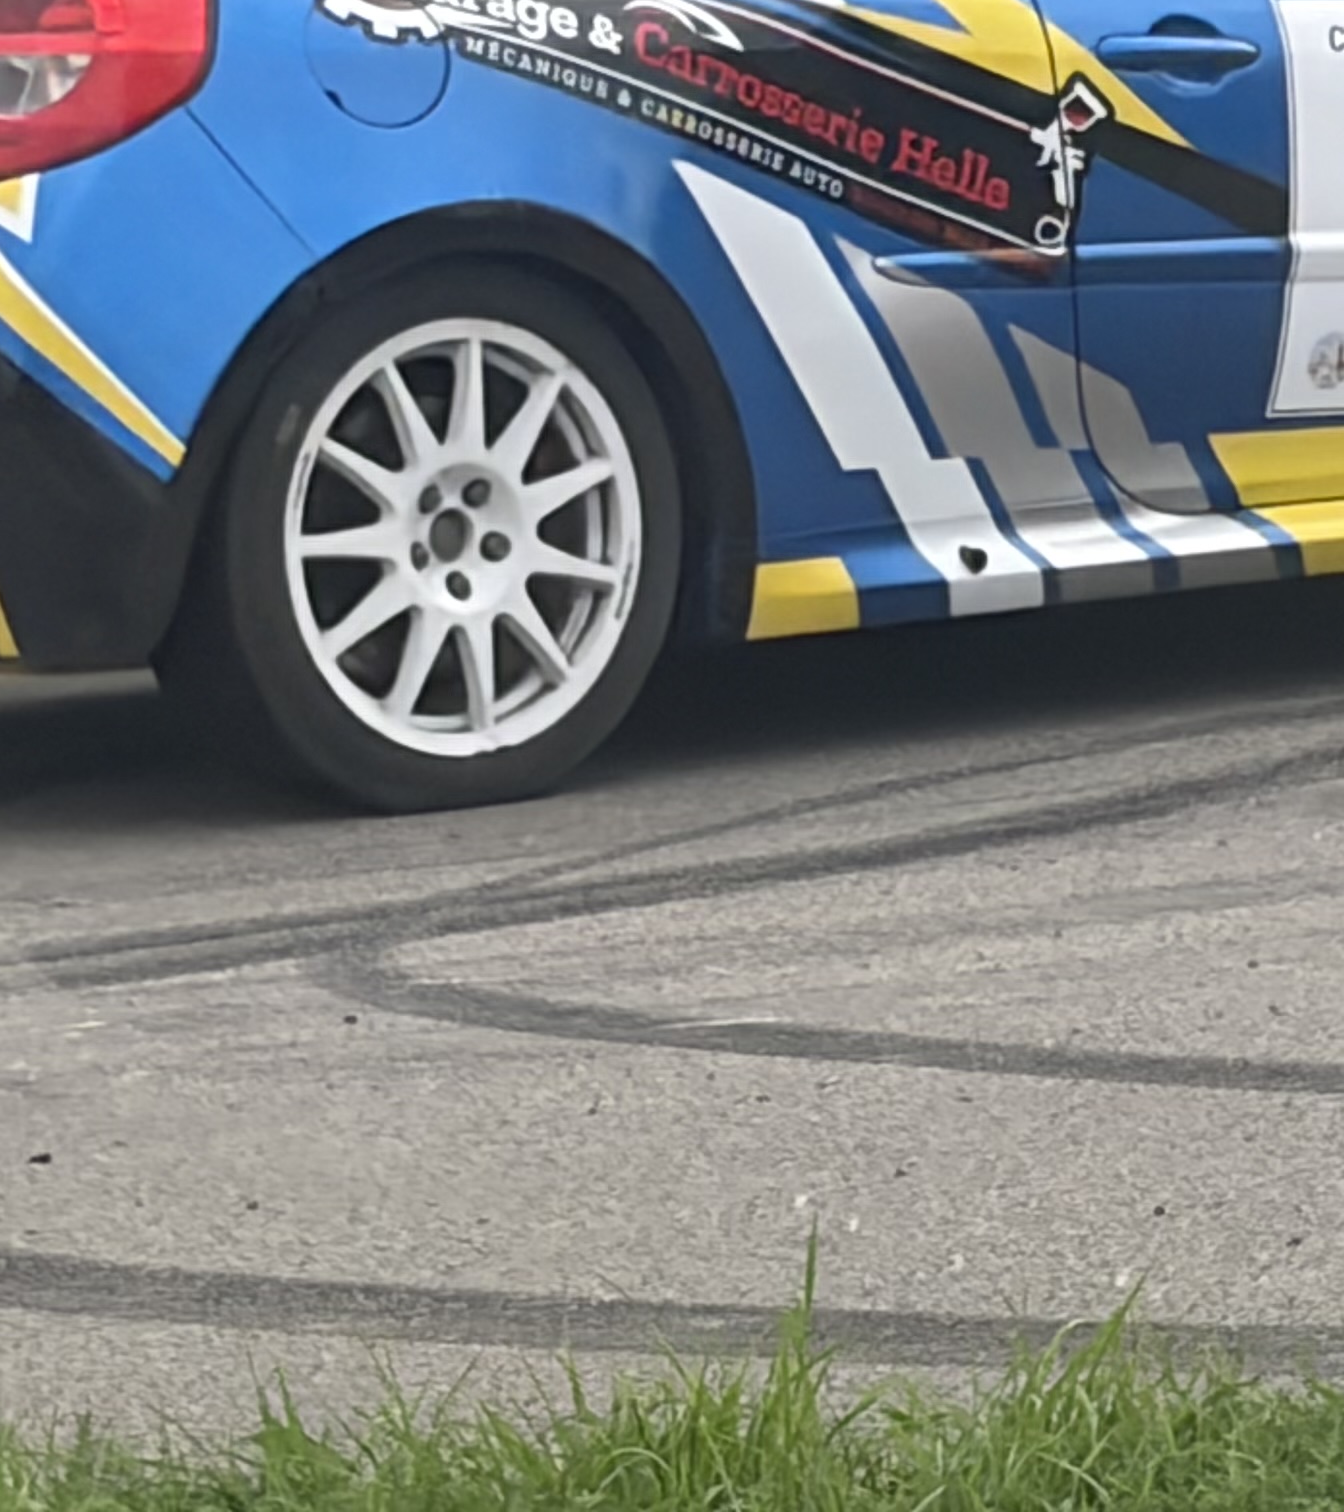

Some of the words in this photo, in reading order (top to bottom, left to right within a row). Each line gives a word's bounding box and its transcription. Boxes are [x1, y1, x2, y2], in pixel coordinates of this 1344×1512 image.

[588, 13, 624, 54] &
[634, 22, 885, 164] Carrosserie
[891, 128, 1011, 211] Helle
[641, 97, 785, 172] CARROSSERIE
[789, 160, 844, 198] AUTO
